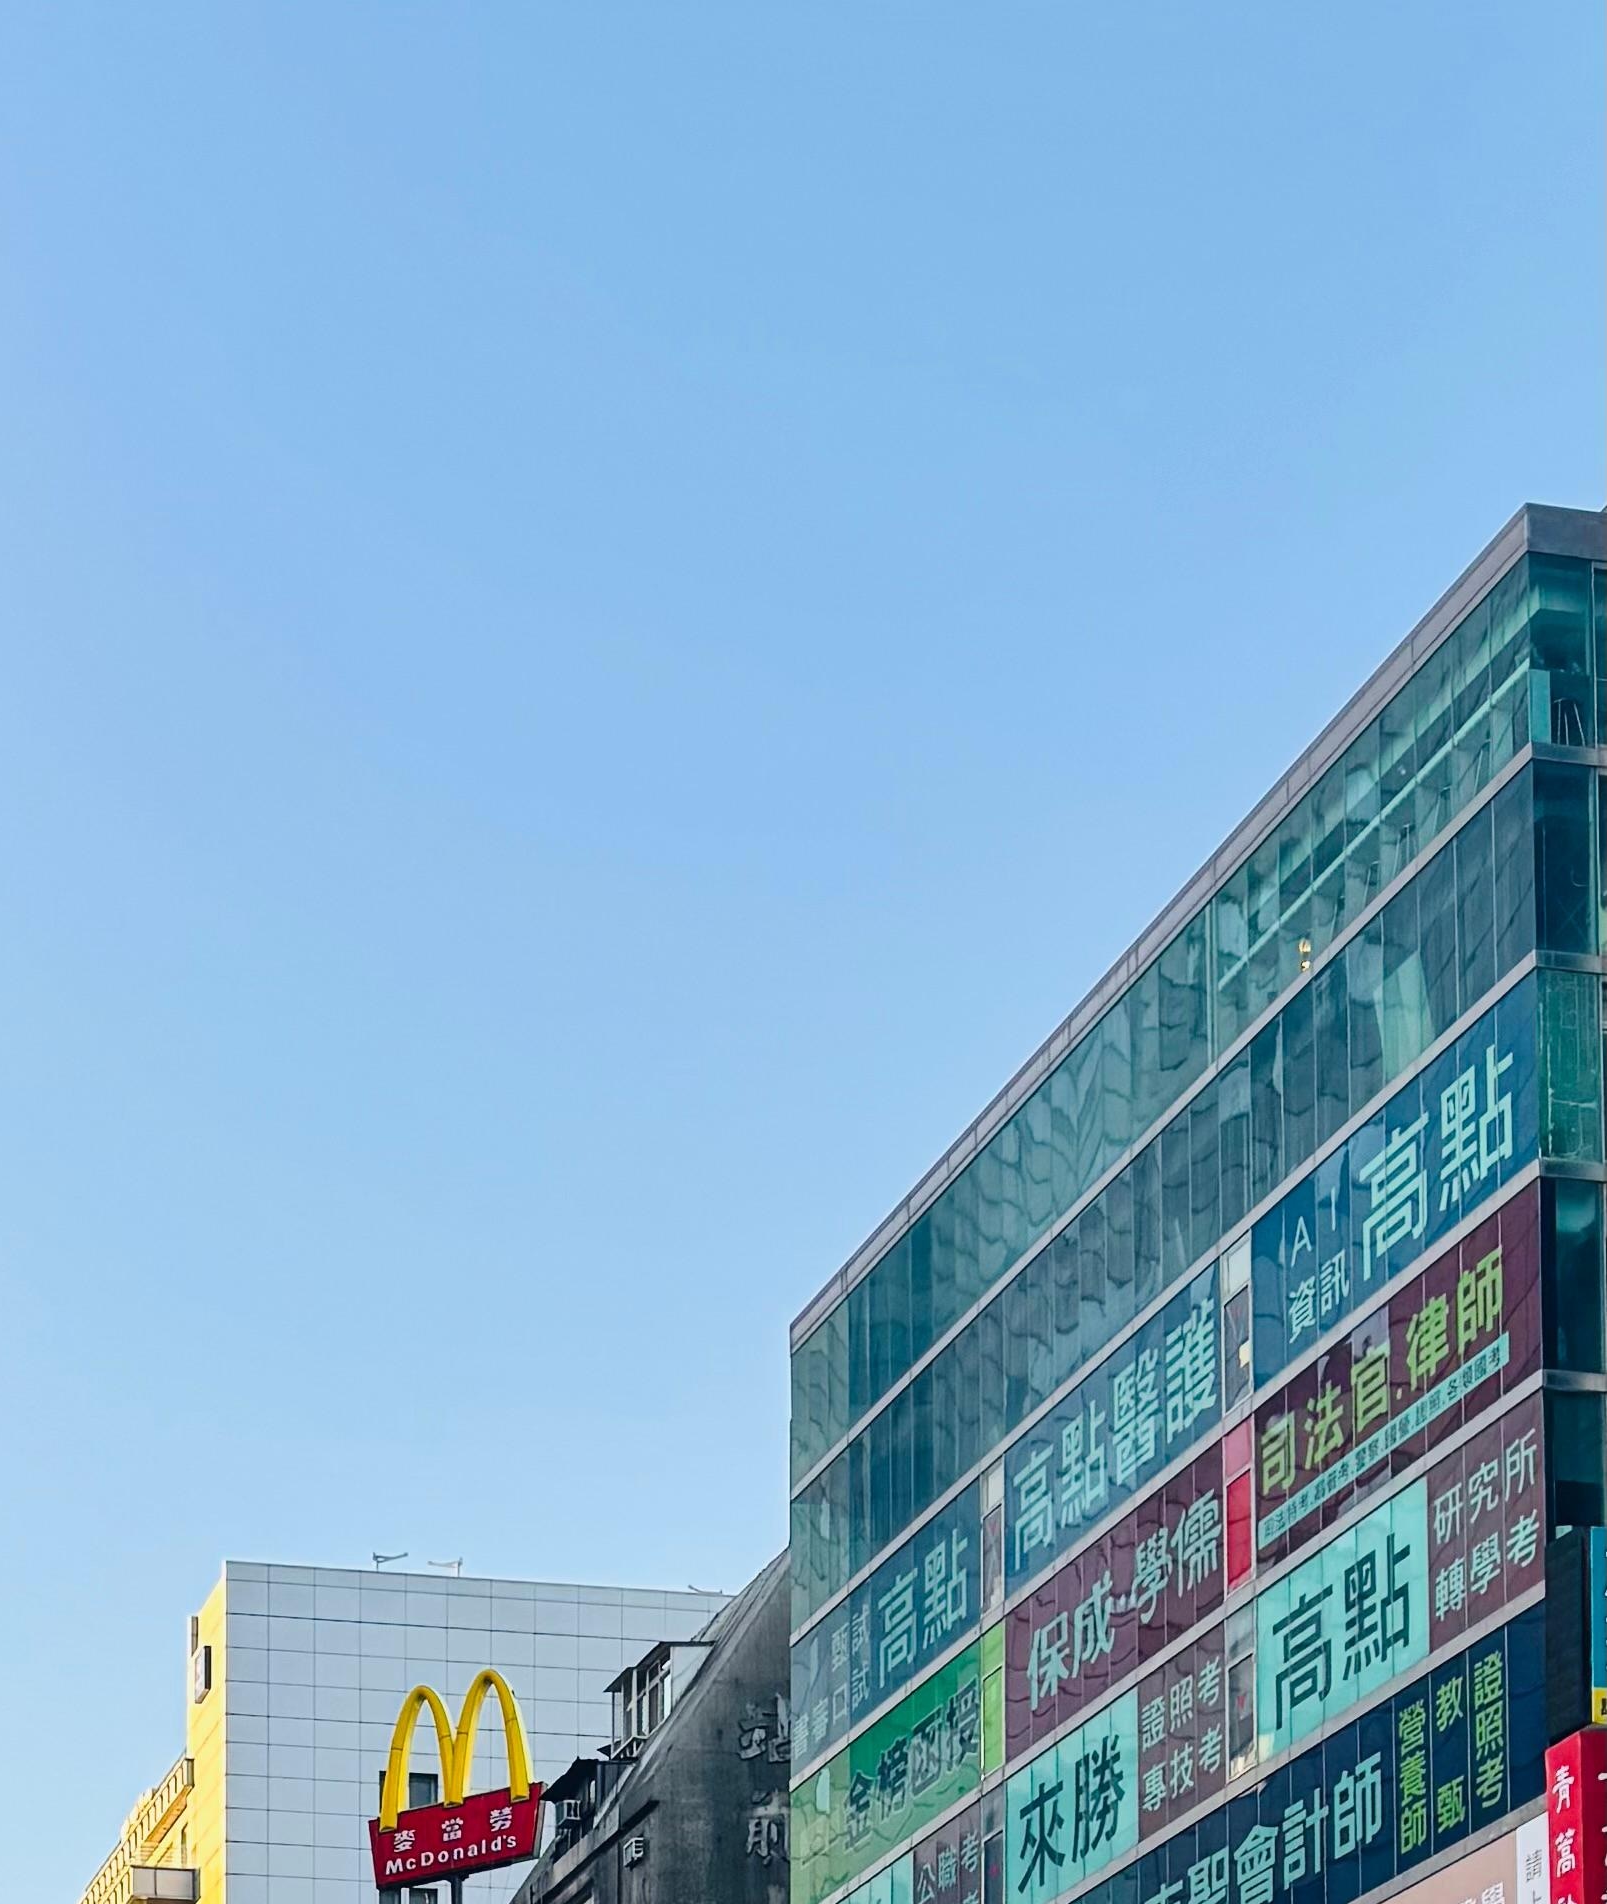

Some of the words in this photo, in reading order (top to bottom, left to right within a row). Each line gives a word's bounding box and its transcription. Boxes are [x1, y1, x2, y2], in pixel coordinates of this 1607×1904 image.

[1358, 1042, 1515, 1283] 高點
[1287, 1248, 1351, 1345] 資訊
[1012, 1296, 1218, 1573] 高點醫護
[1432, 1426, 1537, 1546] 研究所
[878, 1527, 969, 1689] 高點
[1272, 1532, 1412, 1731] 高點
[1434, 1508, 1541, 1622] 轉學考
[1140, 1654, 1222, 1752] 證照考
[1141, 1722, 1222, 1813] 專技考
[1397, 1699, 1428, 1856] 營養師
[1435, 1675, 1465, 1835] 教甄
[1472, 1651, 1504, 1809] 證照考
[385, 1832, 518, 1877] McDonald's
[392, 1805, 515, 1854] 麥當勞
[1017, 1733, 1125, 1894] 來勝
